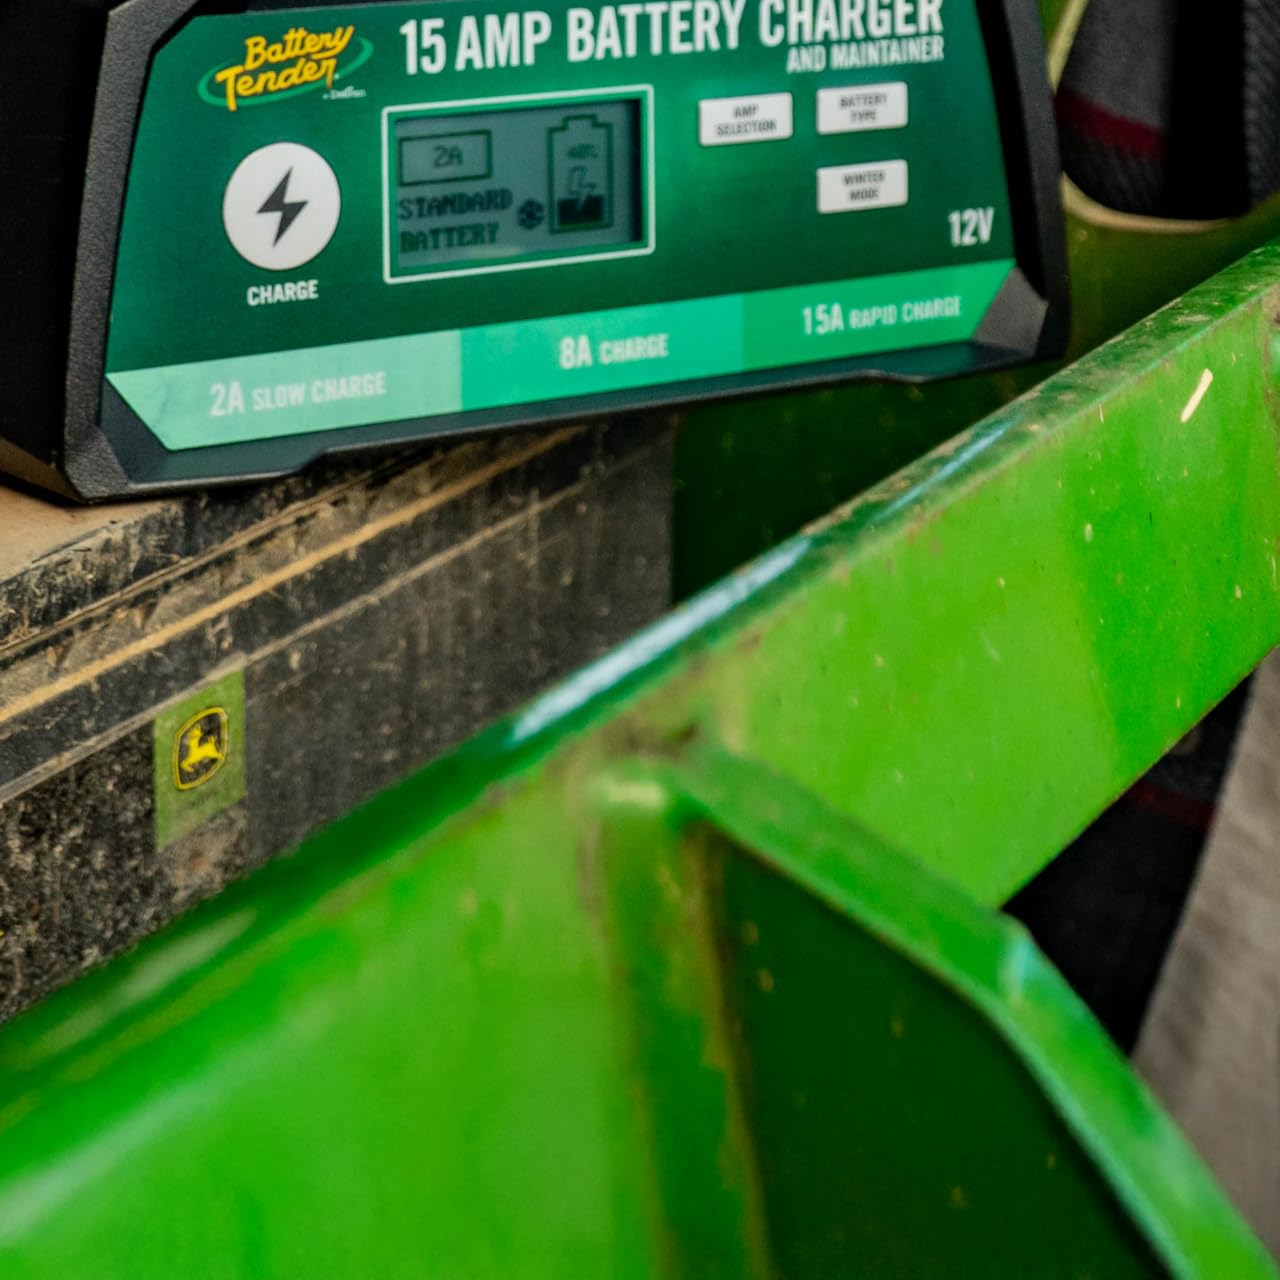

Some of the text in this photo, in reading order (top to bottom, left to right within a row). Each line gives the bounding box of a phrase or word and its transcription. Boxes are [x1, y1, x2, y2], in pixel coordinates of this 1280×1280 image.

[244, 25, 355, 71] Battery
[399, 18, 447, 76] 15
[455, 10, 552, 71] AMP
[786, 34, 945, 74] AND MAINTAINER
[214, 57, 338, 112] Tender
[839, 92, 888, 108] BATTERY
[733, 104, 759, 118] AMP
[850, 109, 877, 123] TYPE
[716, 119, 777, 137] SELECTION
[432, 144, 464, 169] 2A
[843, 170, 886, 186] WINTER
[399, 188, 514, 221] STANDARD
[848, 187, 880, 202] MODE
[399, 222, 500, 254] BATTERY
[947, 206, 995, 247] 12V
[246, 279, 320, 307] CHARGE
[802, 295, 961, 336] 15A RAPID CHARGE
[558, 333, 669, 370] 8A CHARGE
[209, 371, 387, 417] 2A SLOW CHARGE
